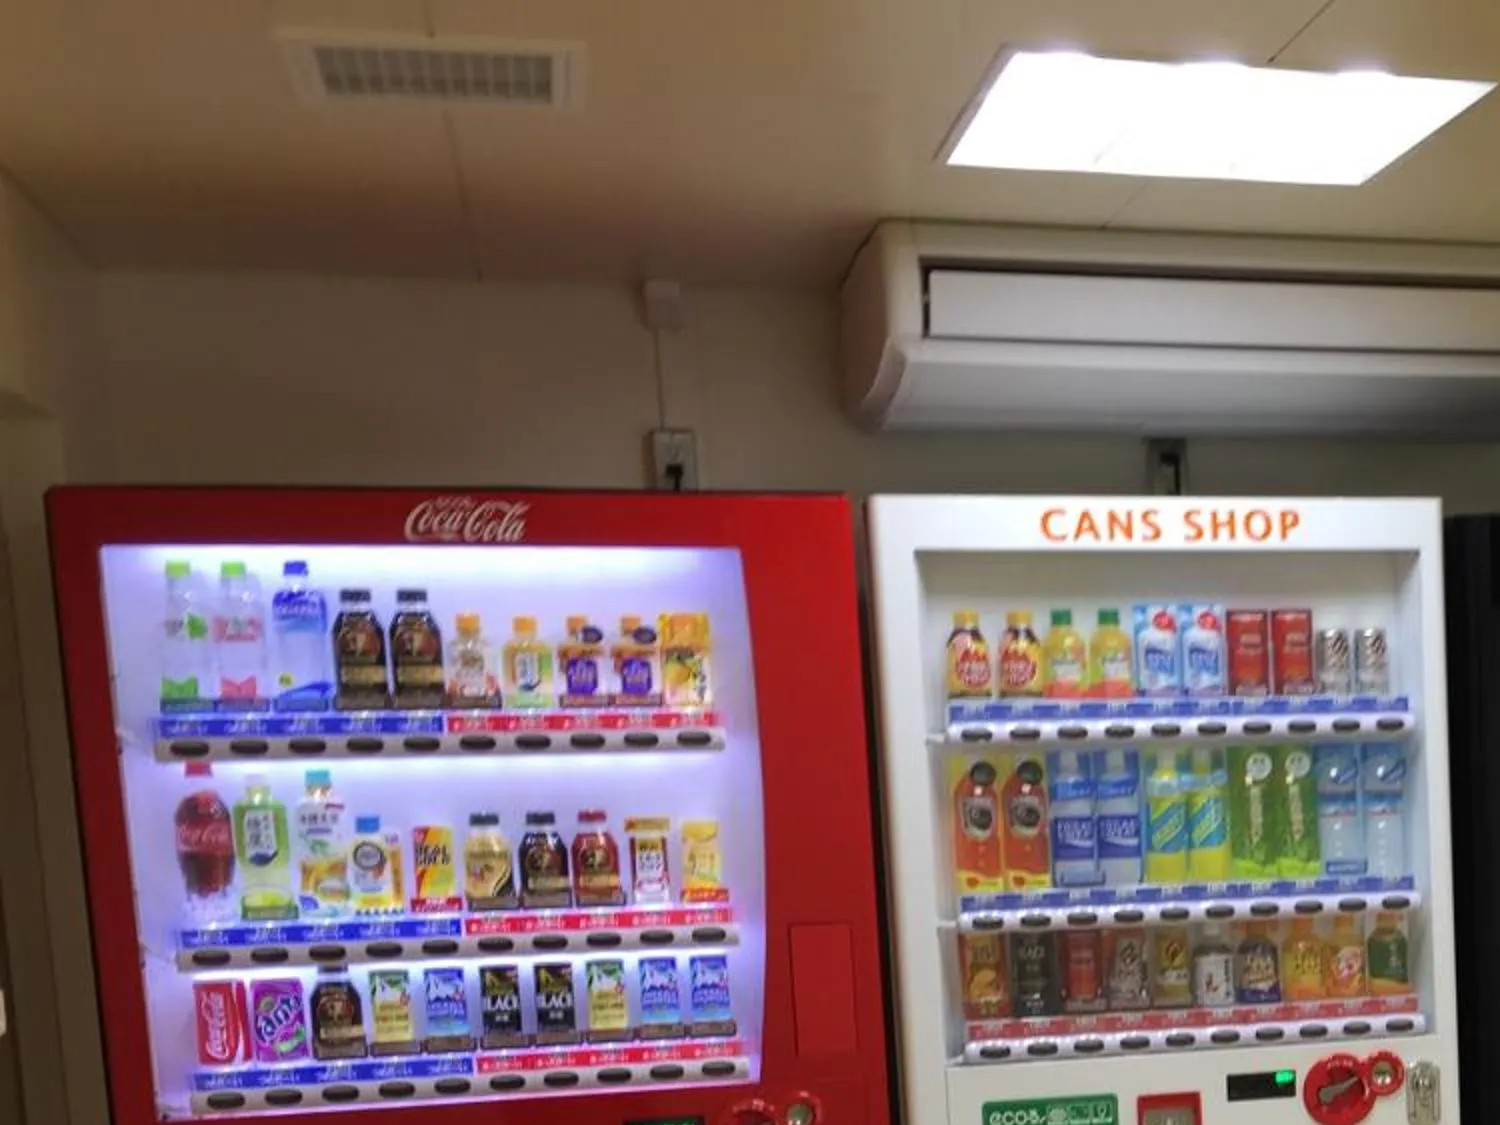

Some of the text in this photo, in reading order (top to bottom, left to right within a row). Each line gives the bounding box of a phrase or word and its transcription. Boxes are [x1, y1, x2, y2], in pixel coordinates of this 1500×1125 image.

[404, 498, 531, 543] Coca-Cola
[1040, 508, 1301, 542] CANS SHOP
